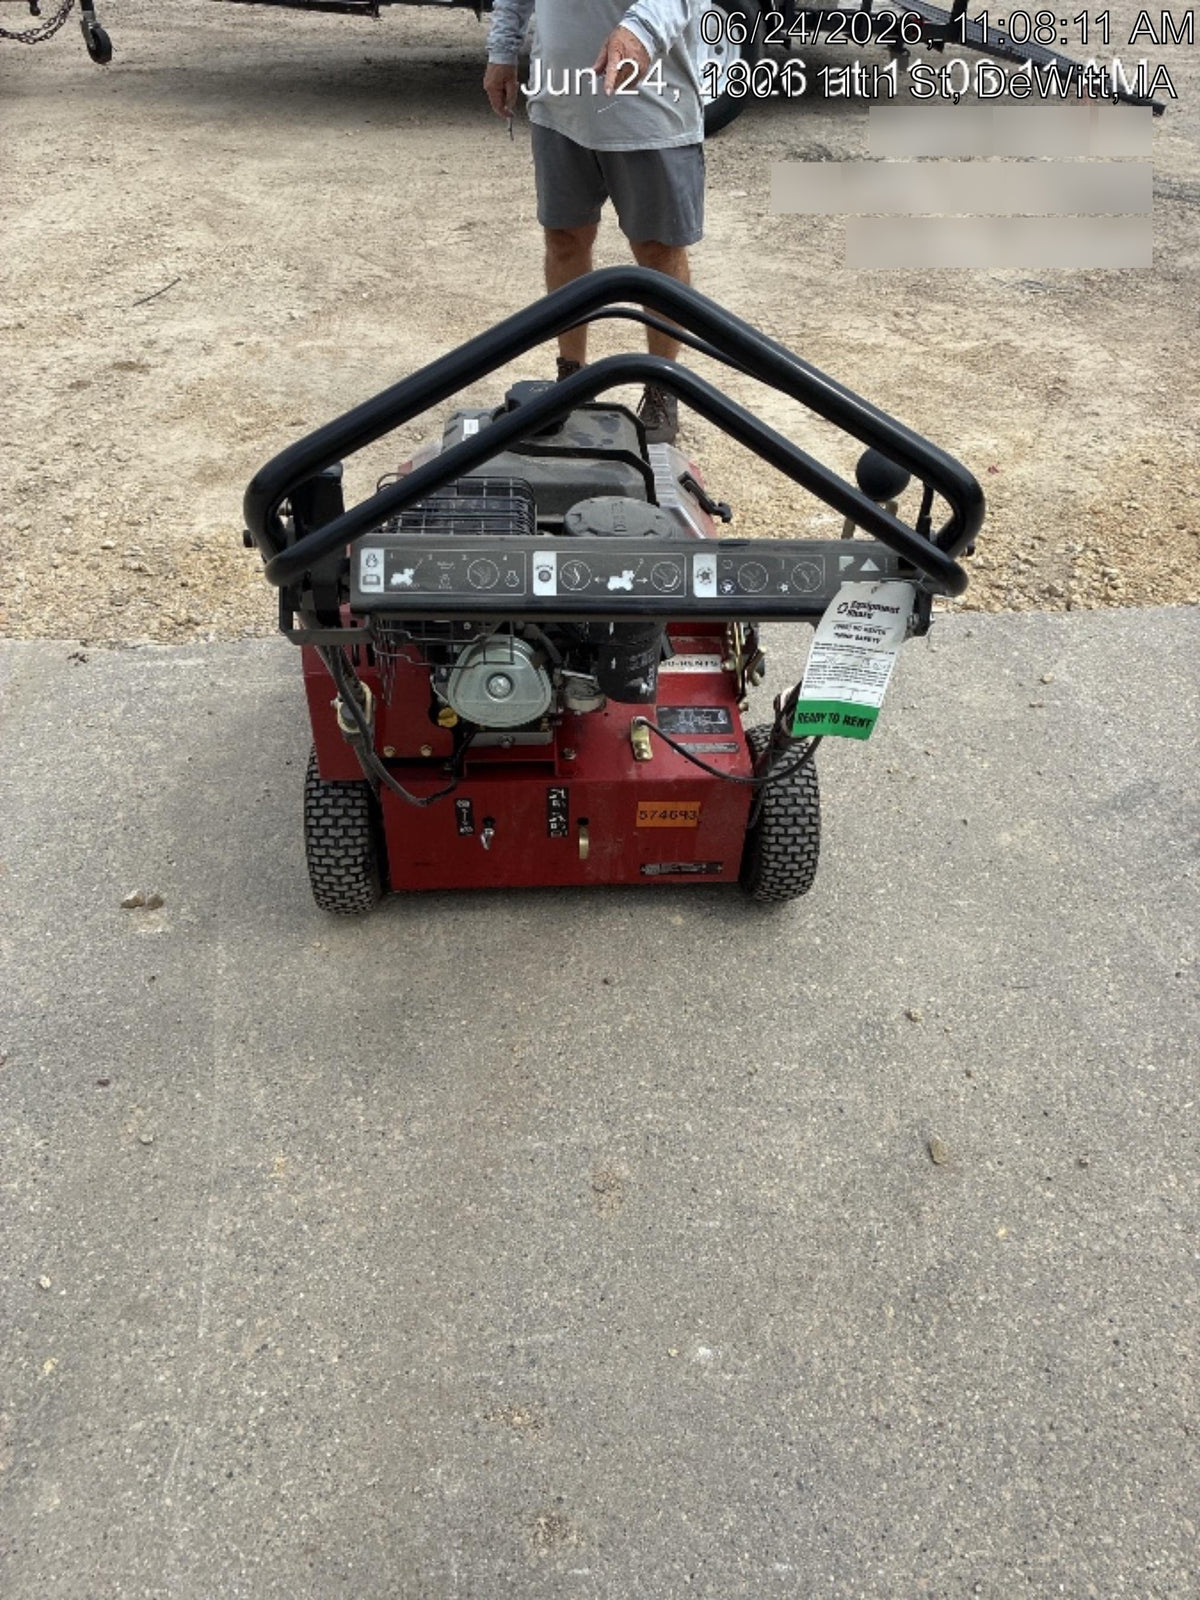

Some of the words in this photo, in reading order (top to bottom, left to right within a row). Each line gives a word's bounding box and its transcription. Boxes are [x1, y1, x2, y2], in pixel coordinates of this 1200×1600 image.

[797, 712, 828, 725] READY
[828, 712, 840, 725] TO
[842, 714, 873, 729] RENT
